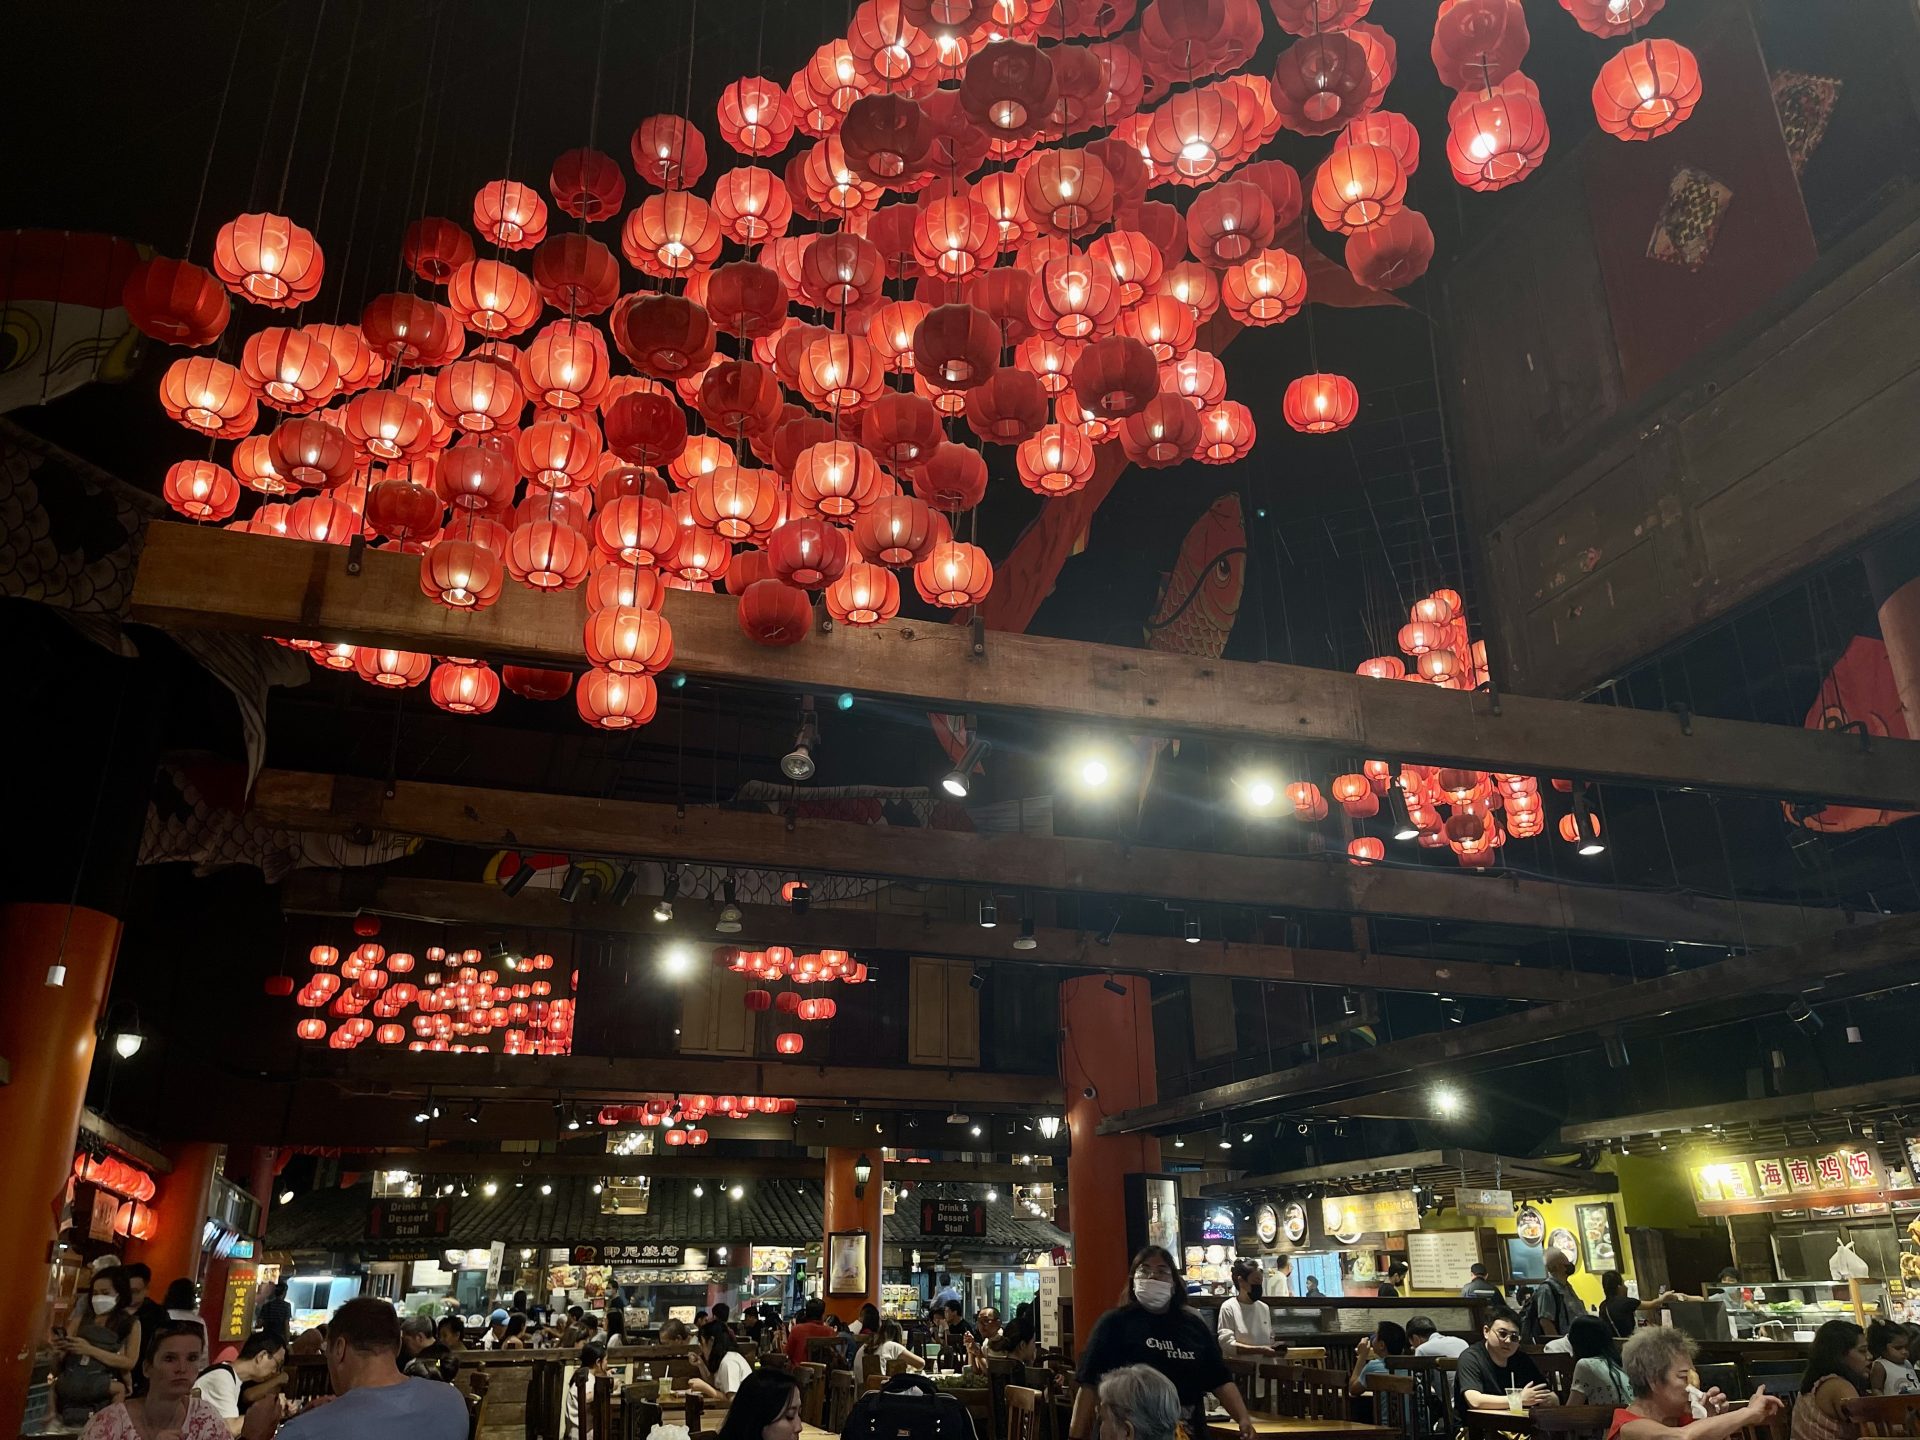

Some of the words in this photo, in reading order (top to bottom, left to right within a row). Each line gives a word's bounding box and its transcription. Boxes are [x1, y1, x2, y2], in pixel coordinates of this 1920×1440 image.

[1760, 1152, 1873, 1186] 海南鸡饭
[390, 1202, 417, 1212] Drink
[420, 1201, 428, 1211] &
[938, 1203, 960, 1212] Drink
[962, 1204, 968, 1212] &
[388, 1213, 429, 1223] Dessert
[937, 1213, 969, 1222] Dessert
[395, 1225, 420, 1235] Stall
[944, 1224, 963, 1233] Stall
[1042, 1276, 1056, 1284] RETURN
[1146, 1337, 1174, 1350] Chill
[1166, 1348, 1196, 1360] relax
